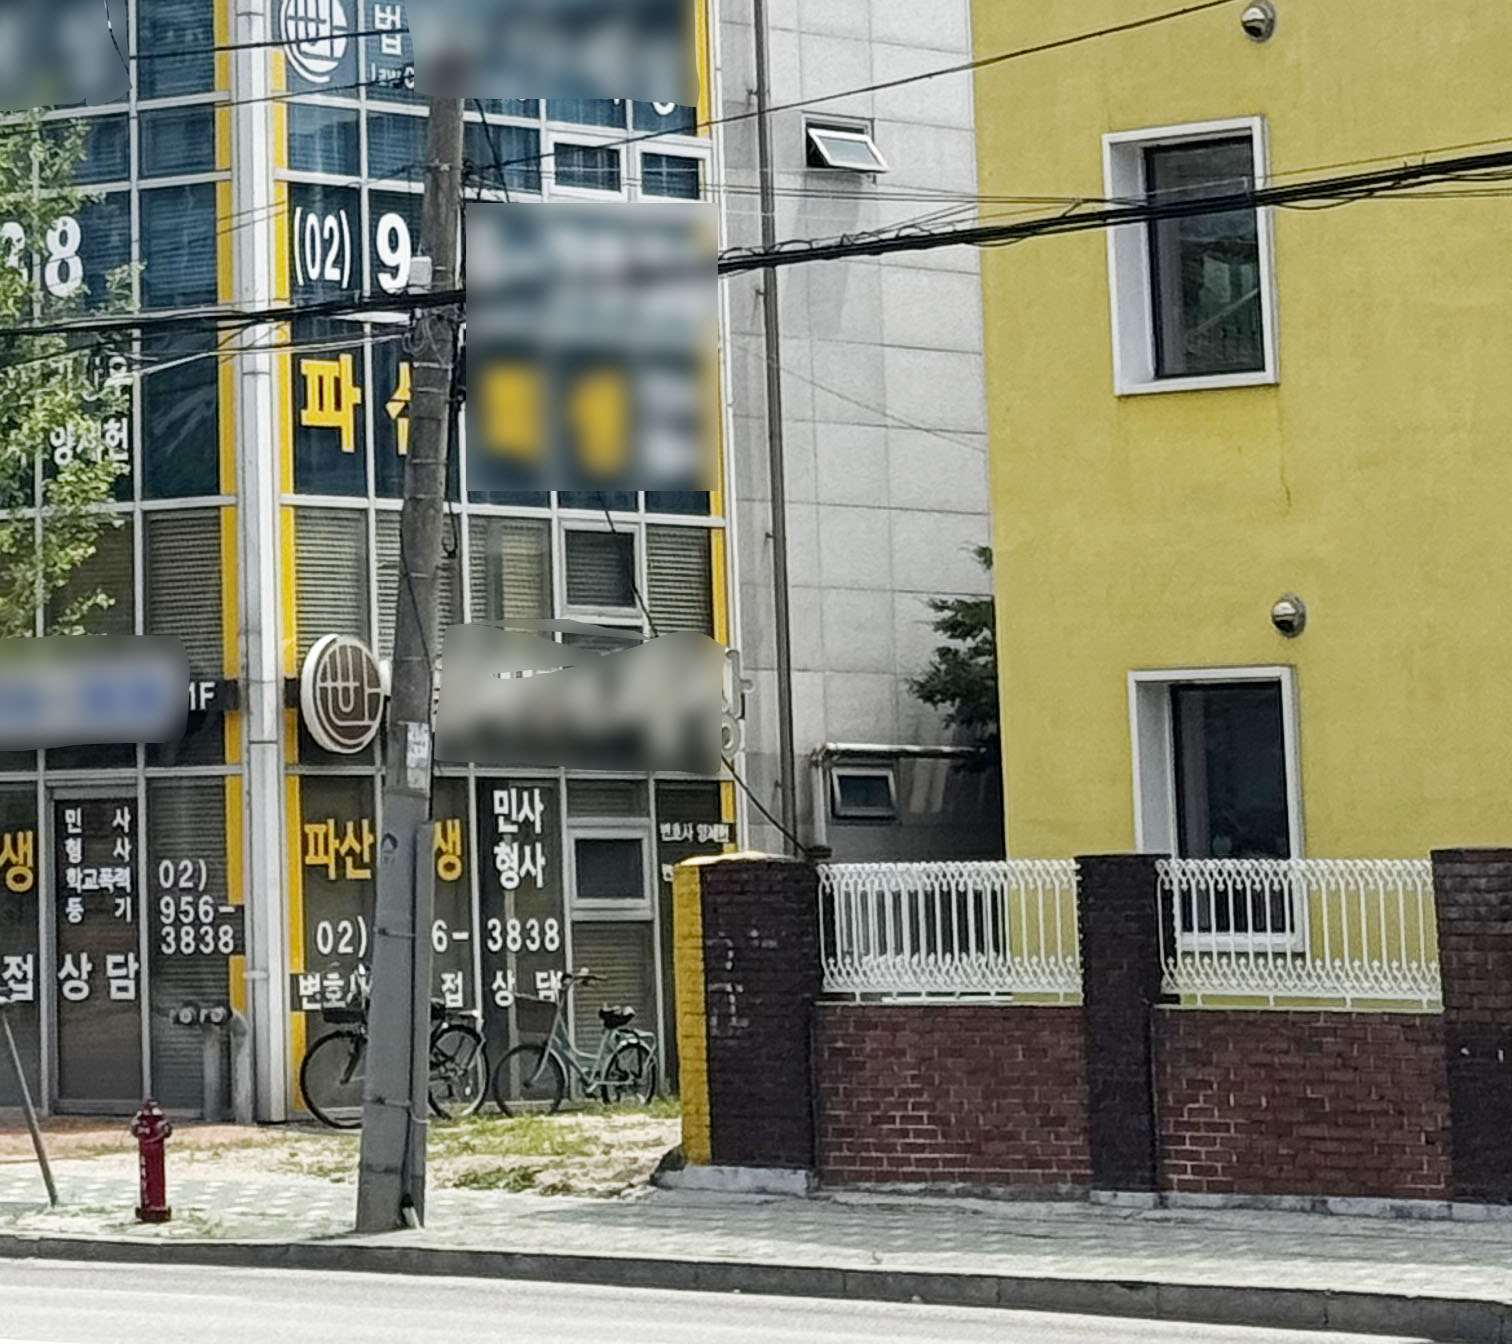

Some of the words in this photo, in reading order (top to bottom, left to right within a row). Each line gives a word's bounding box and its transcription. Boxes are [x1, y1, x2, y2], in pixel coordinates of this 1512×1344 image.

[293, 205, 351, 290] (02)
[493, 788, 545, 835] 민사
[65, 867, 132, 893] 학교폭력
[158, 859, 208, 892] 02)
[494, 841, 548, 892] 형사
[159, 895, 236, 924] 956-
[160, 924, 235, 955] 3838
[315, 915, 368, 959] 02)
[486, 917, 562, 954] 3838
